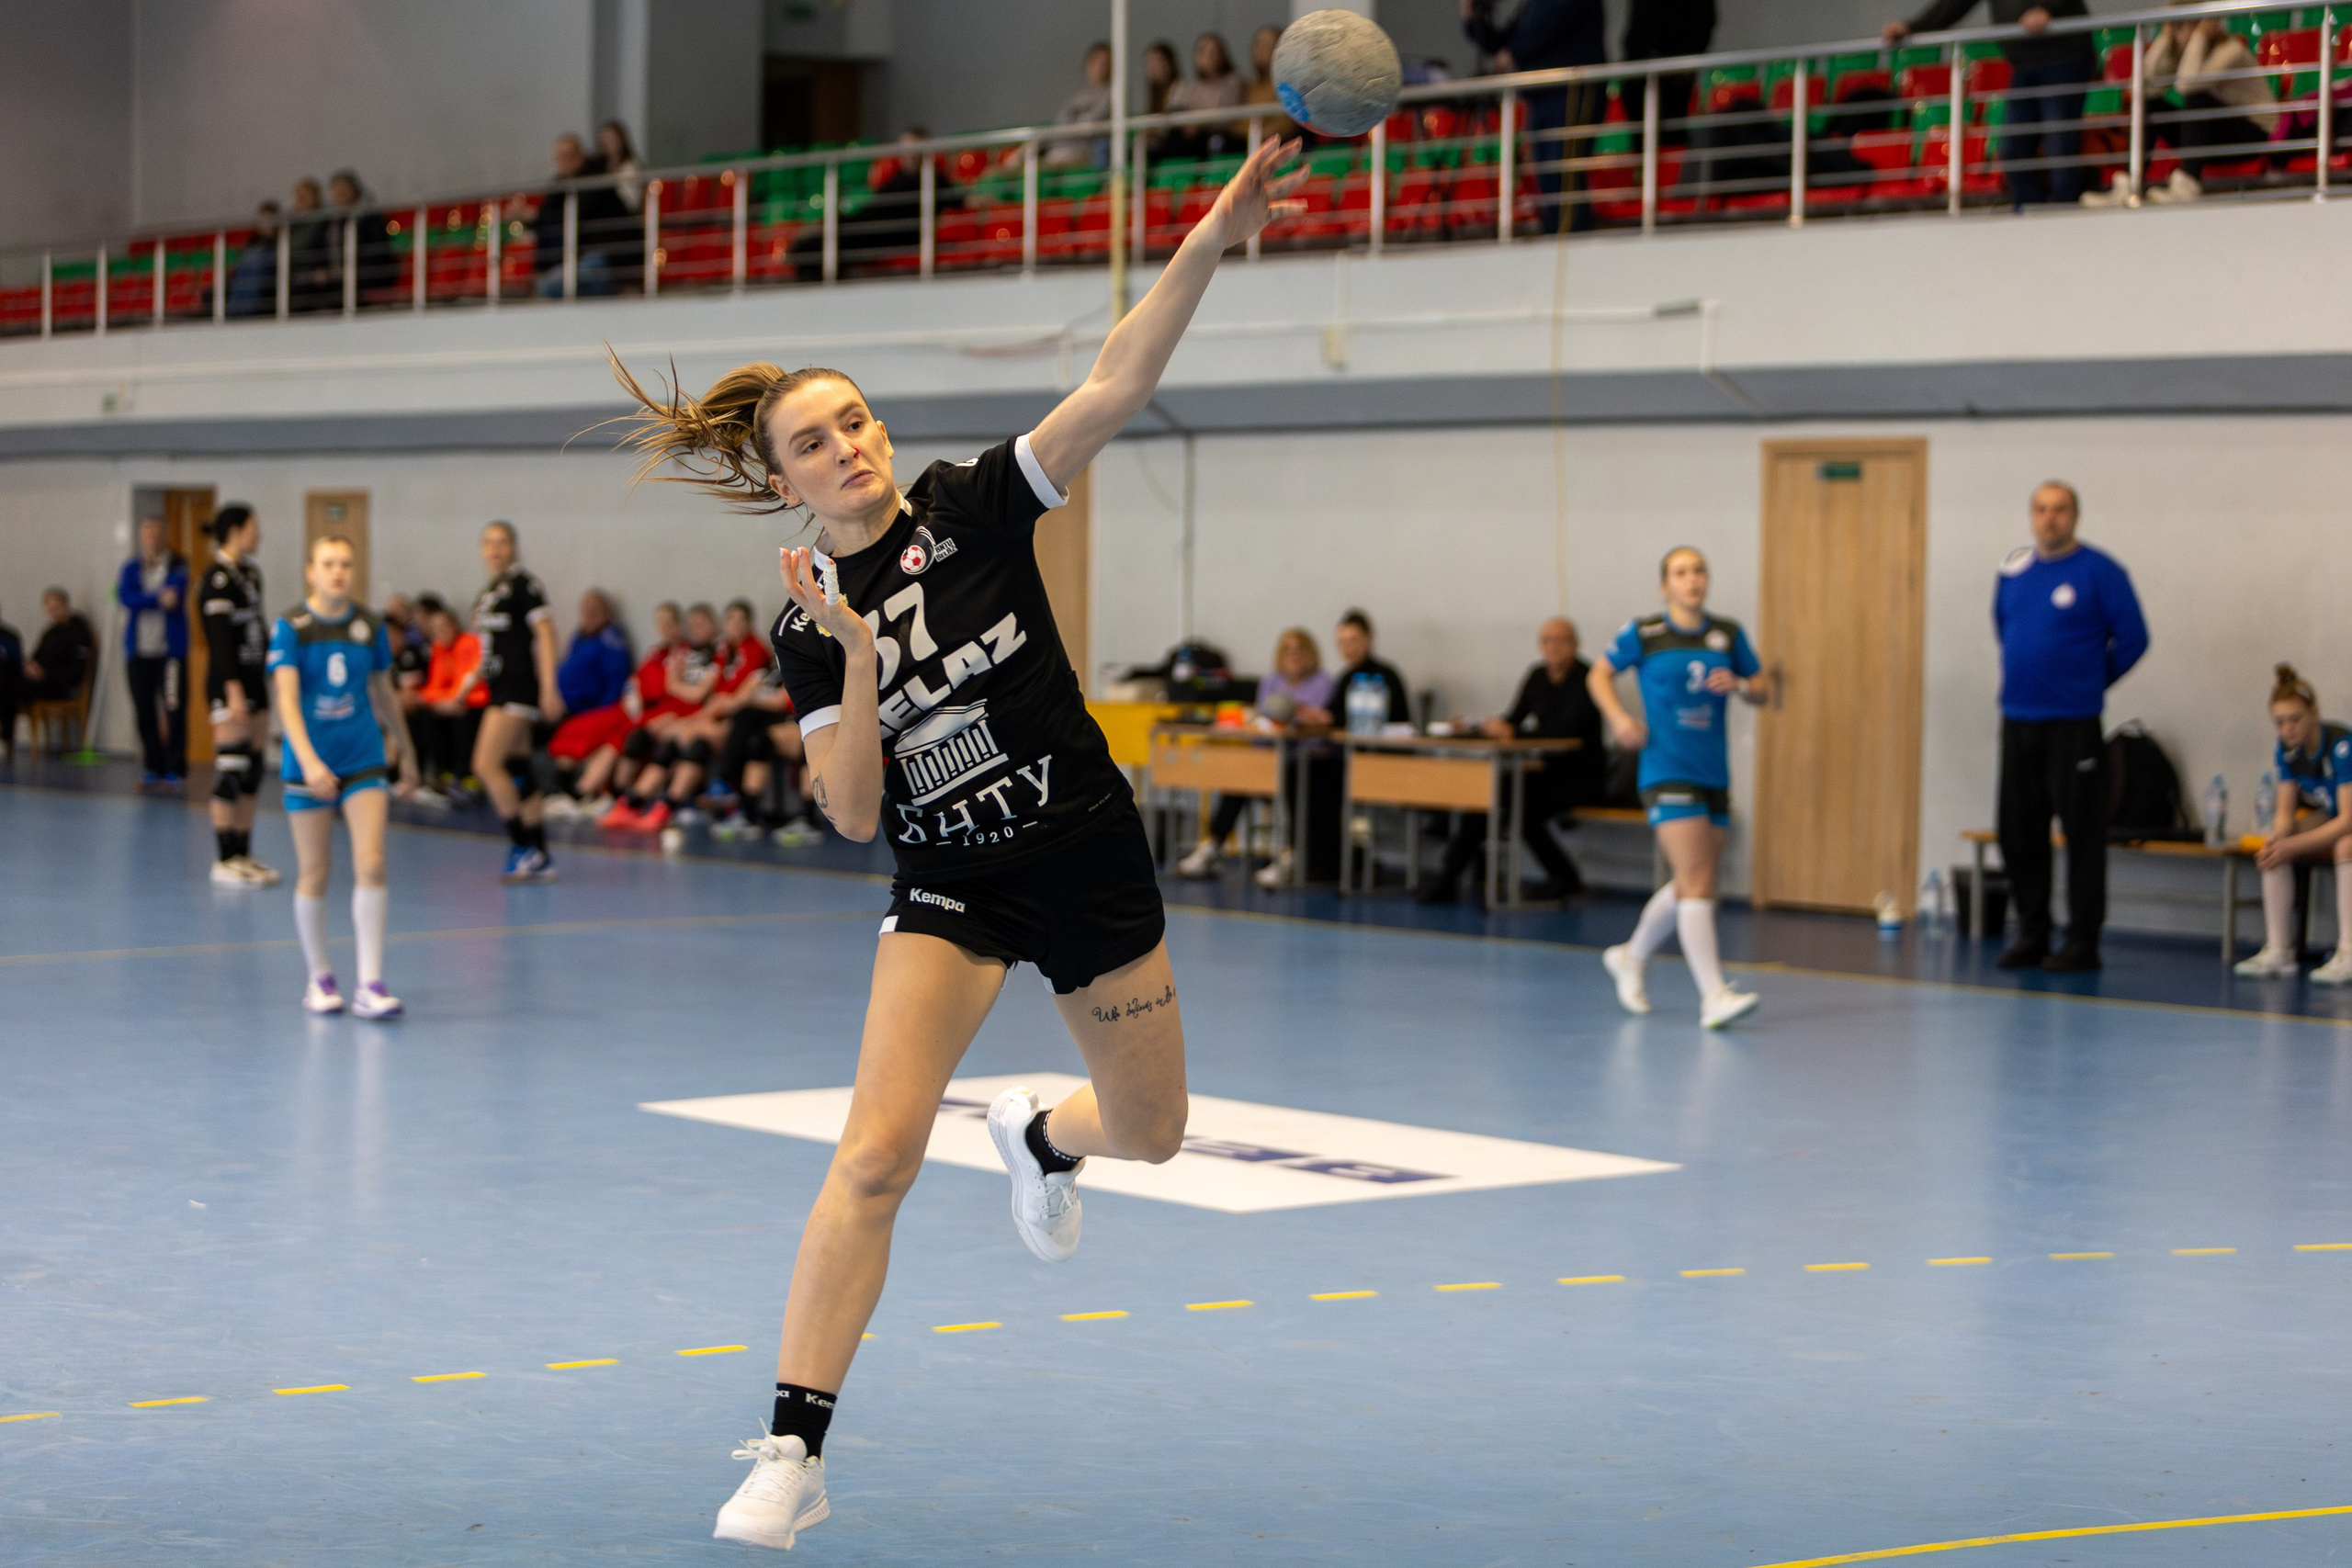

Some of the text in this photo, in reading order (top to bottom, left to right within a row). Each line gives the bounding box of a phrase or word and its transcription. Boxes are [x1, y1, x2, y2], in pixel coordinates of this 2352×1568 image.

[862, 581, 939, 691] 37
[878, 612, 1027, 739] ELAZ
[896, 754, 1053, 844] БНТУ
[963, 826, 1014, 846] 1920
[910, 887, 966, 913] Kempa
